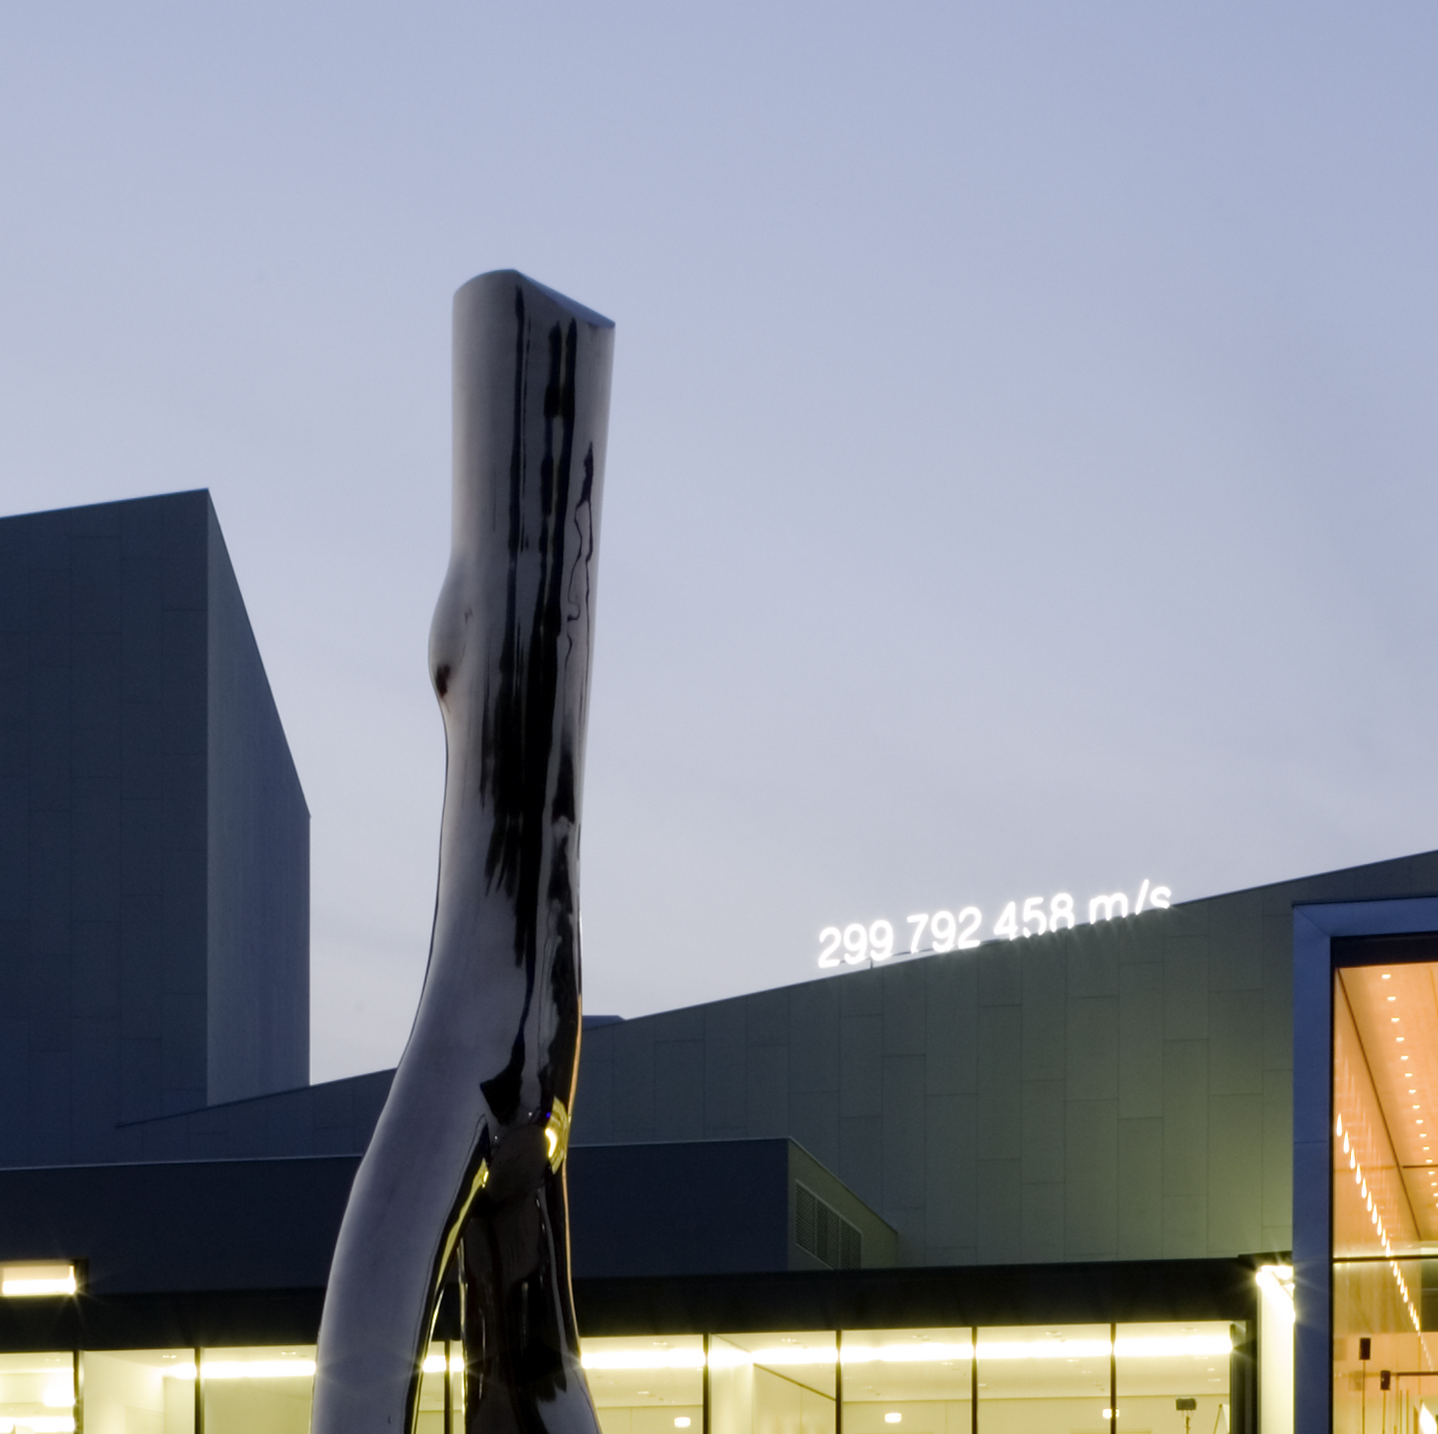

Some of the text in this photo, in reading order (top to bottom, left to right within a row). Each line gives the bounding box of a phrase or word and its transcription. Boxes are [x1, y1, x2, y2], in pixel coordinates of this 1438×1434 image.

[818, 879, 1172, 968] 299 792 458 m/s
